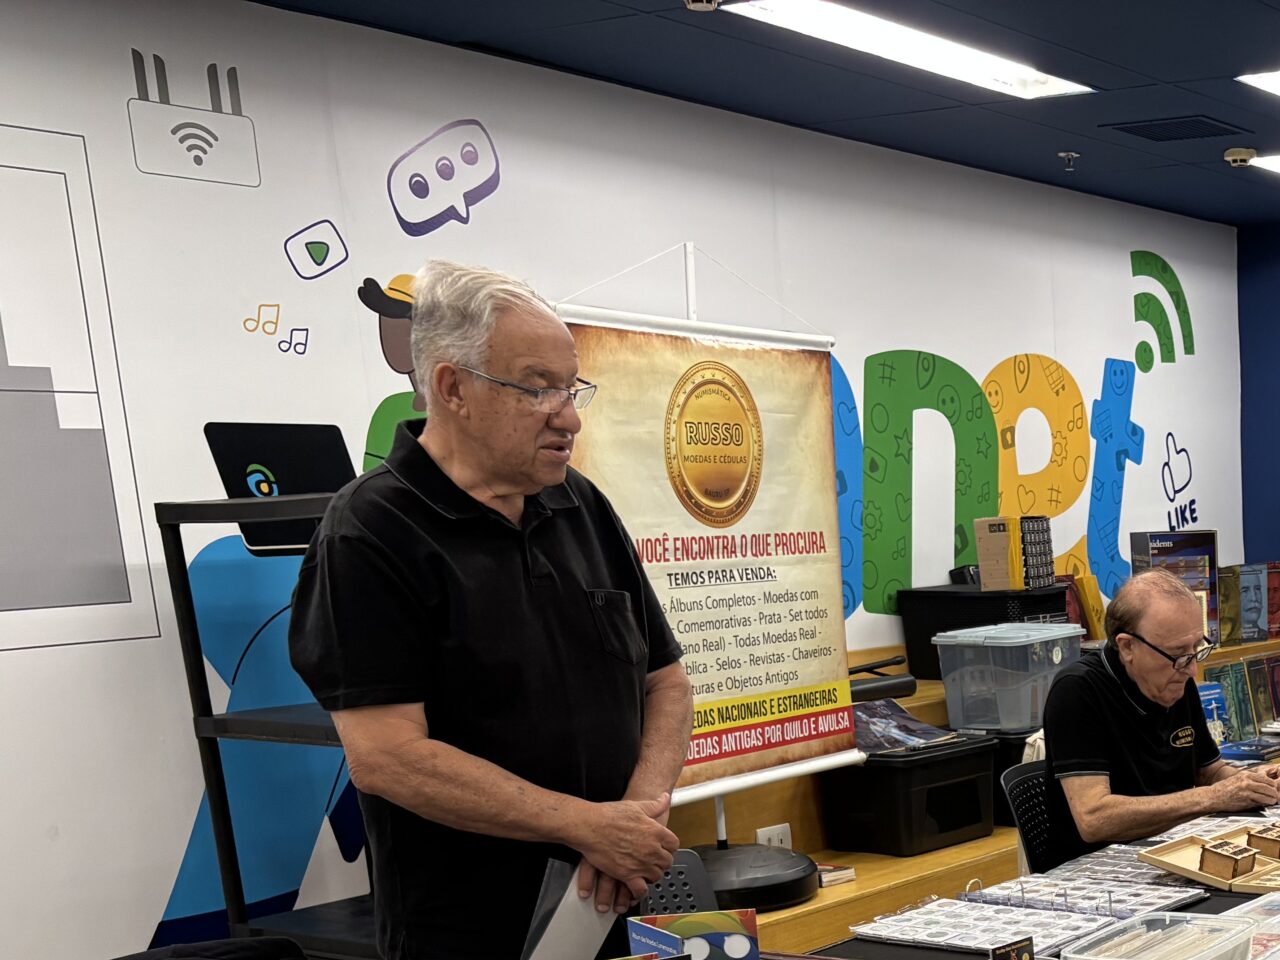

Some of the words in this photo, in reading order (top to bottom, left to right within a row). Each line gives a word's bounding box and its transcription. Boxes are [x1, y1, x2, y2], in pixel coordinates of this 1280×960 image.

[694, 387, 731, 402] NUMISMÁTICA
[685, 421, 744, 446] RUSSO
[683, 454, 712, 464] MOEDAS
[713, 455, 718, 463] E
[718, 454, 747, 464] CÉDULAS
[1168, 499, 1198, 532] LIKE
[636, 532, 671, 564] VOCÊ
[673, 535, 738, 562] ENCONTRA
[740, 534, 748, 558] O
[750, 533, 772, 559] QUE
[774, 531, 827, 556] PROCURA
[667, 571, 706, 587] TEMOS
[708, 569, 735, 584] PARA
[737, 566, 777, 582] VENDA:
[670, 596, 704, 613] Álbuns
[705, 593, 756, 613] Completos
[763, 589, 799, 605] Moedas
[800, 588, 819, 601] com
[677, 615, 752, 634] Comemorativas
[759, 611, 782, 626] Prata
[789, 608, 803, 622] Set
[804, 607, 828, 621] todos
[702, 637, 726, 653] Real)
[733, 634, 761, 649] Todas
[762, 631, 798, 647] Moedas
[799, 626, 817, 641] Real
[716, 656, 742, 672] Selos
[749, 652, 785, 667] Revistas
[792, 646, 832, 661] Chaveiros
[717, 682, 723, 691] e
[726, 673, 763, 692] Objetos
[765, 669, 799, 686] Antigos
[718, 700, 767, 724] NACIONAIS
[770, 699, 775, 715] E
[778, 687, 838, 714] ESTRANGEIRAS
[685, 736, 719, 761] OEDAS
[722, 727, 762, 753] ANTIGAS
[765, 725, 783, 745] POR
[784, 720, 809, 741] QUILO
[811, 717, 816, 735] E
[818, 711, 850, 733] AVULSA
